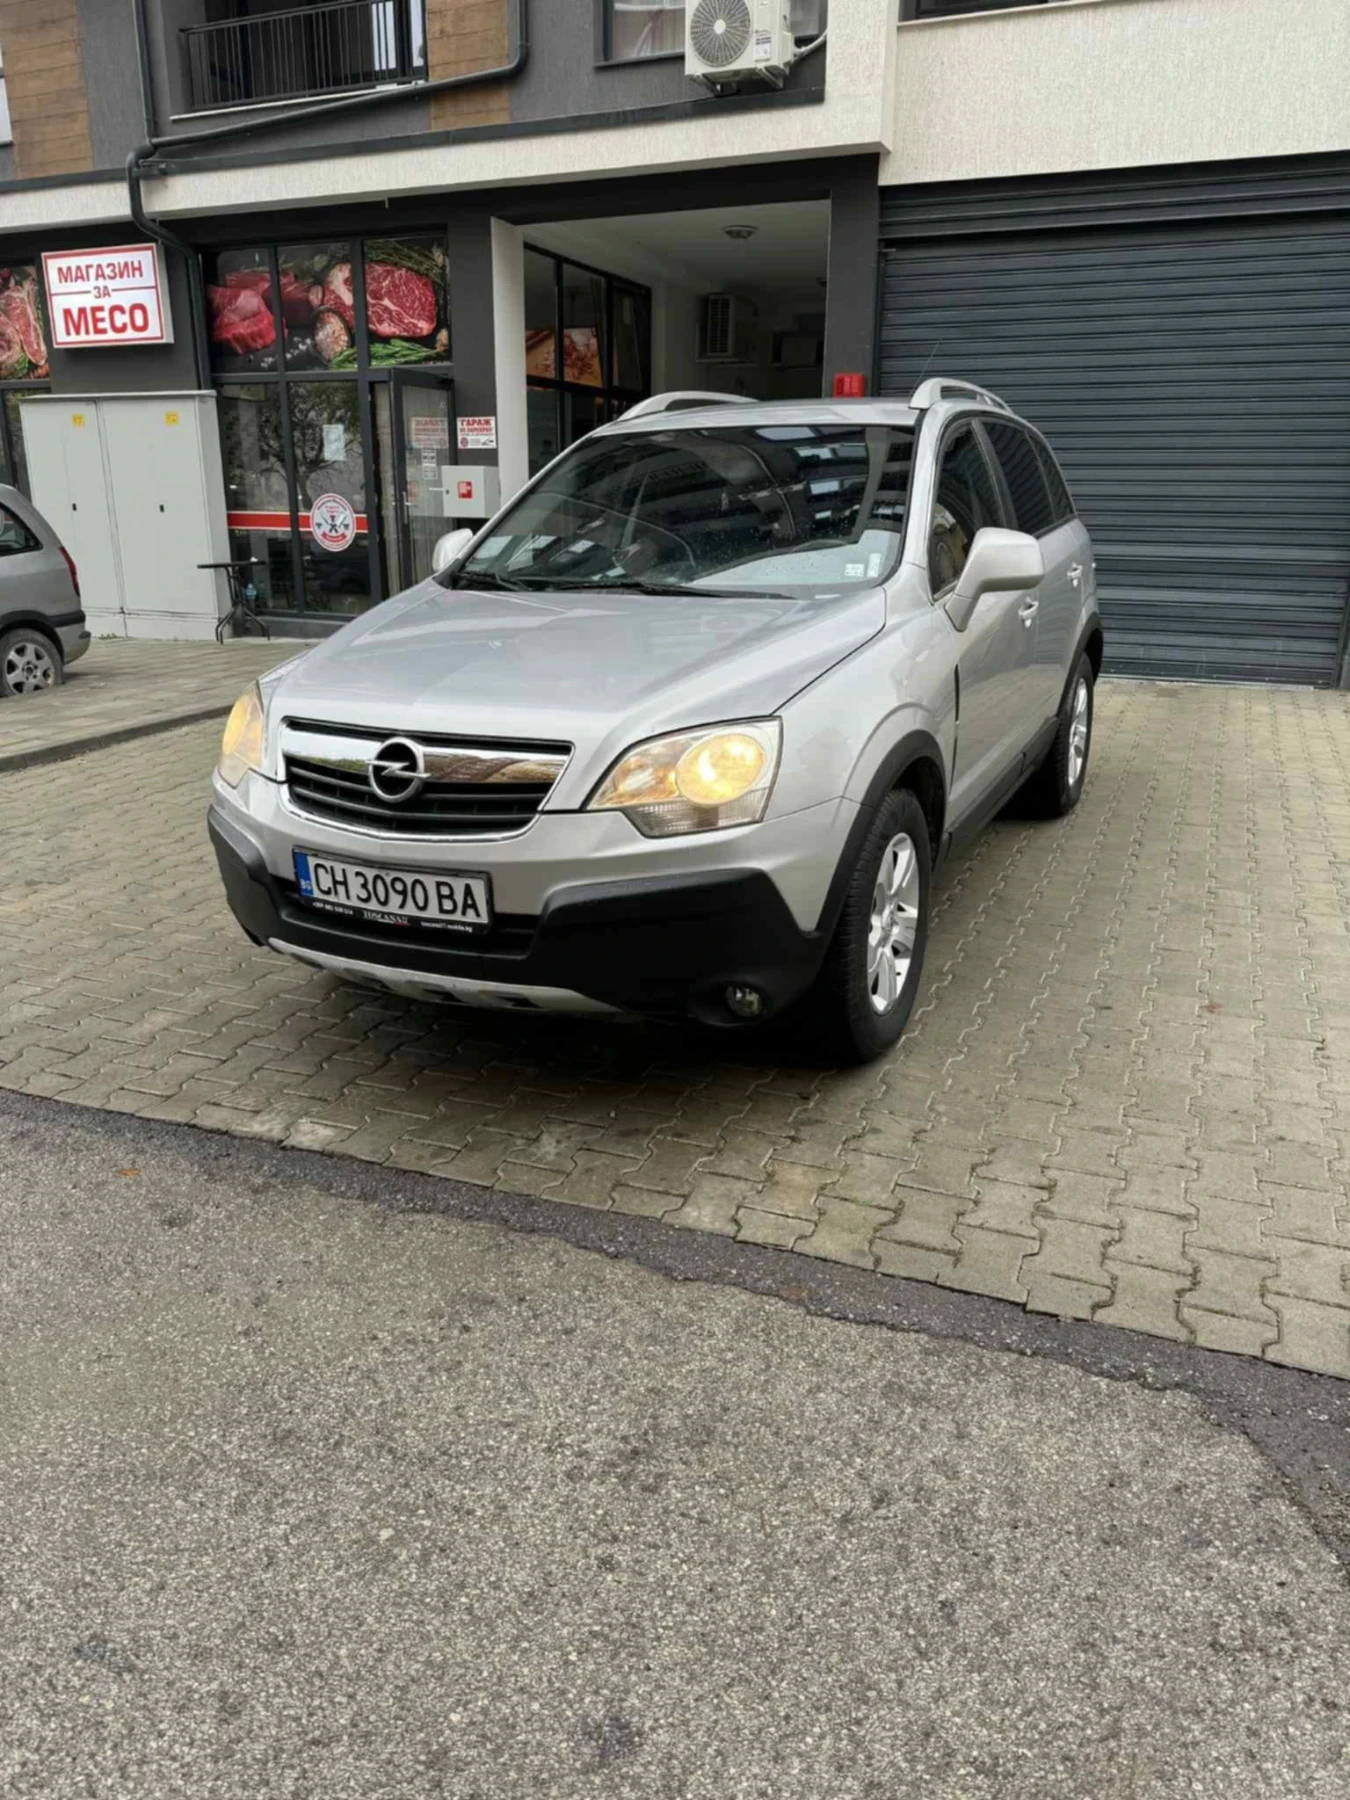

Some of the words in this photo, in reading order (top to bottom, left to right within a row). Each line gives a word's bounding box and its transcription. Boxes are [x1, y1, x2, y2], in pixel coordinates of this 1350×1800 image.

[57, 260, 143, 284] МАГАЗИН
[93, 285, 111, 299] ЗА
[62, 303, 149, 336] МЕСО
[460, 418, 492, 426] ГАРАЖ
